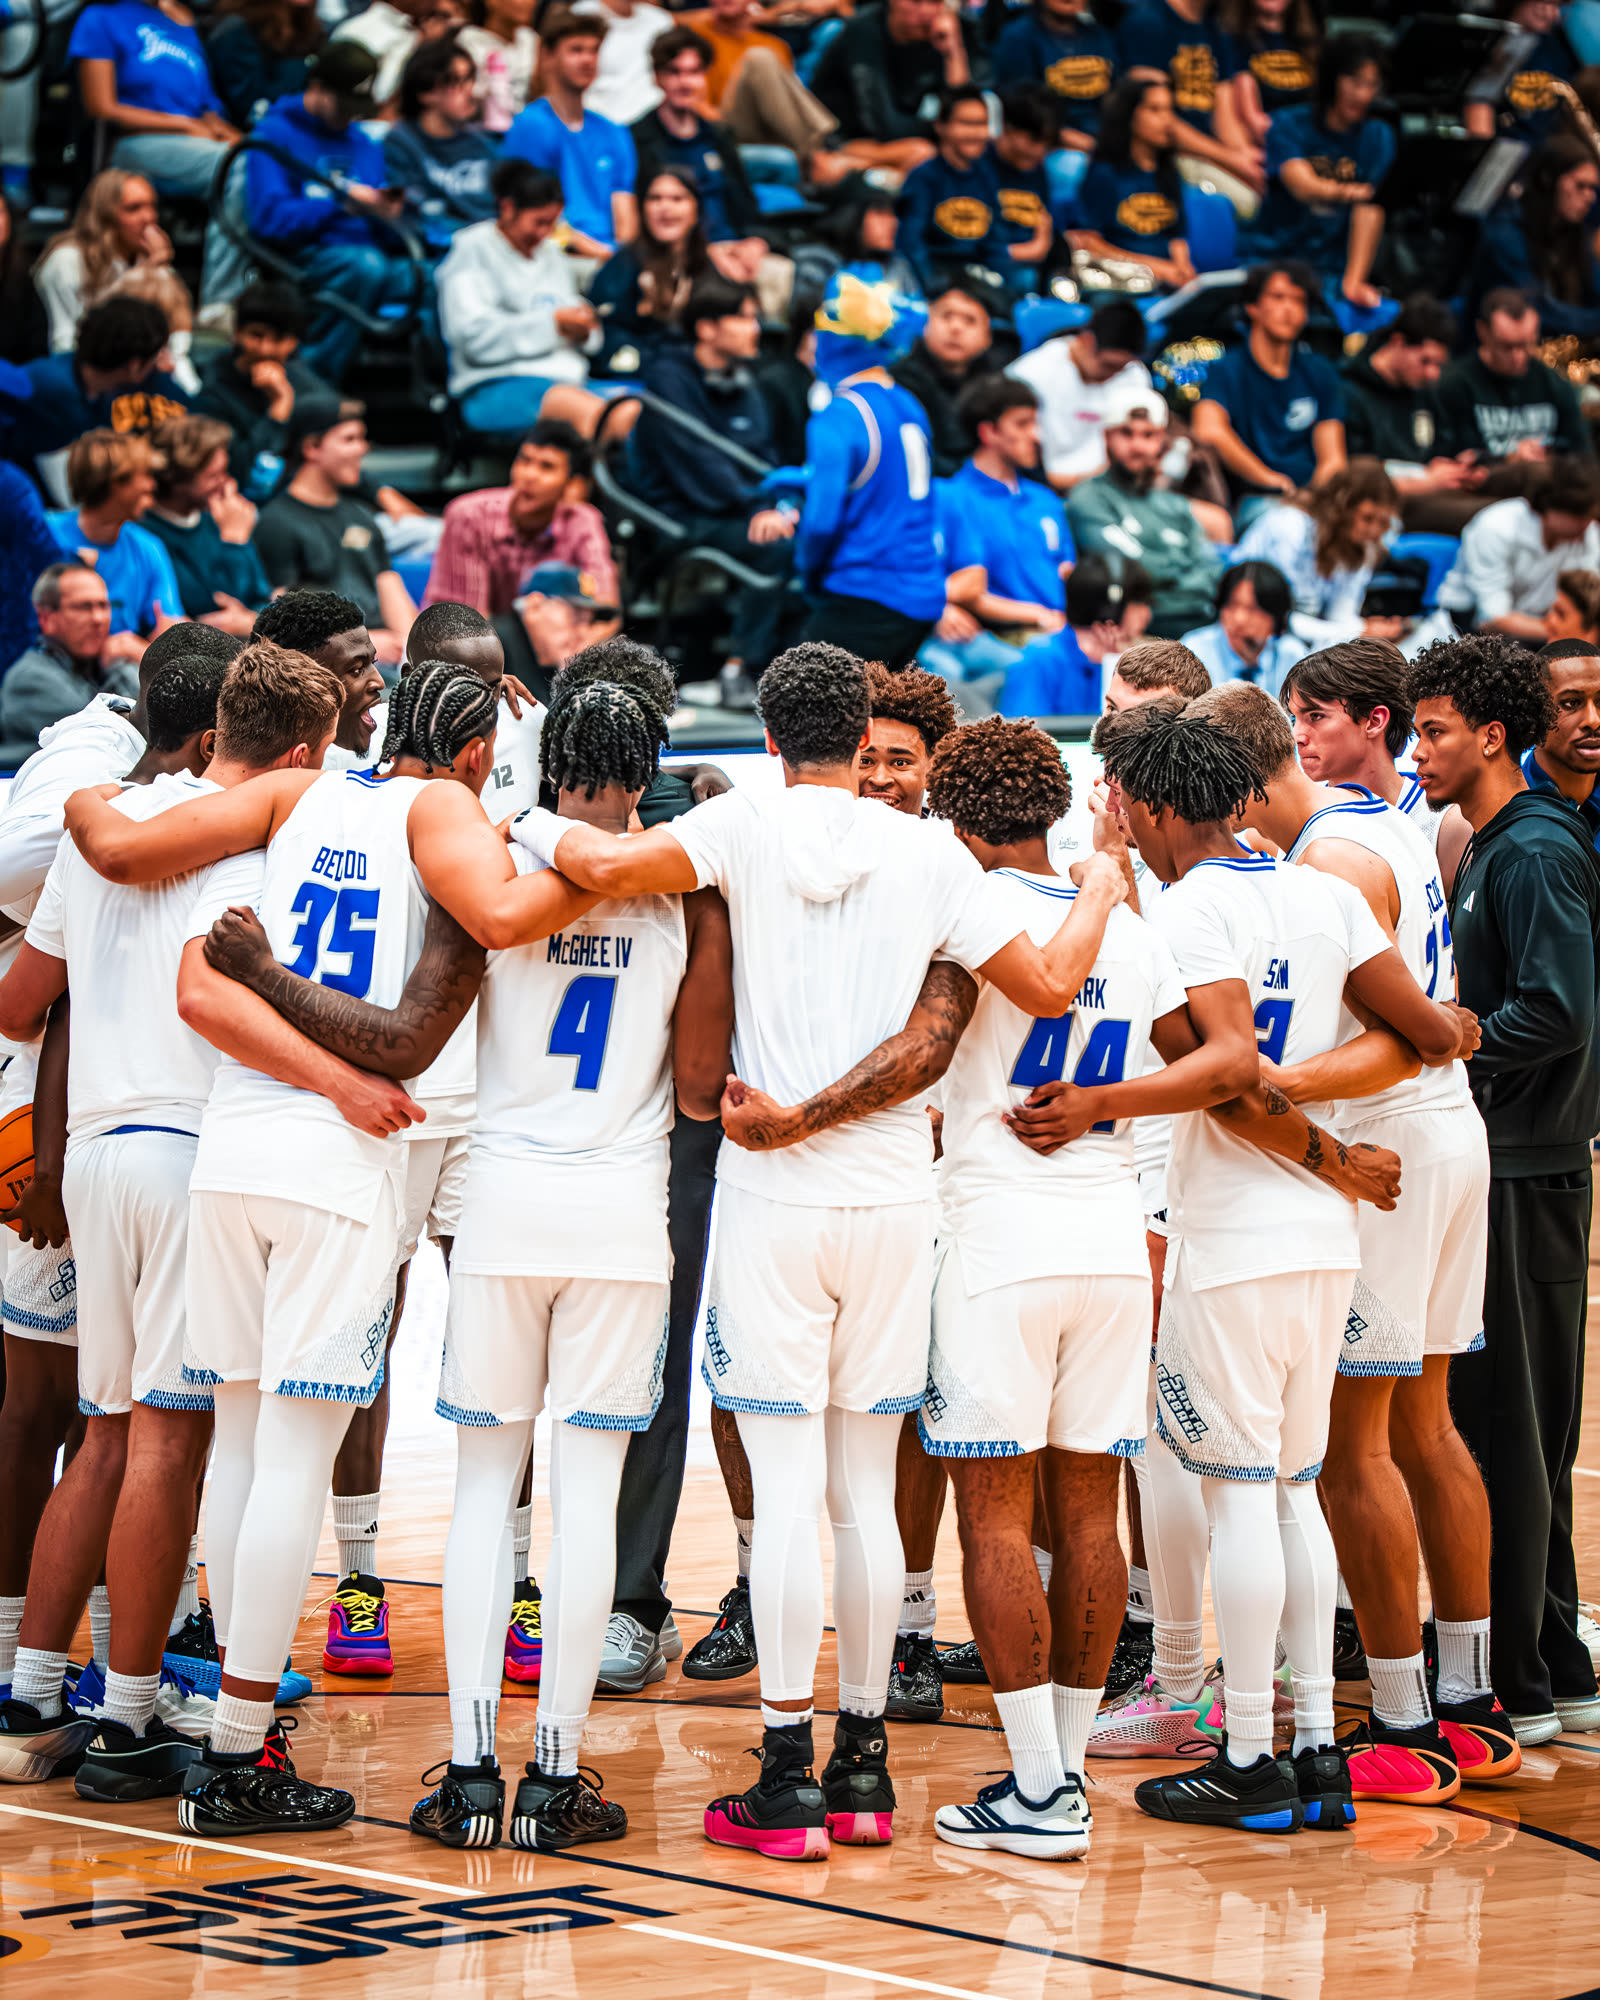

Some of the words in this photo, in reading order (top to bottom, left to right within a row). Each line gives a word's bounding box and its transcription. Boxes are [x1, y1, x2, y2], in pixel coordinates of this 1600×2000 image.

[491, 764, 514, 789] 12
[281, 880, 380, 1000] 35
[547, 933, 611, 968] McGHEE
[615, 936, 632, 968] IV
[546, 973, 619, 1093] 4
[1008, 1010, 1132, 1135] 44
[147, 1884, 679, 1967] WEST
